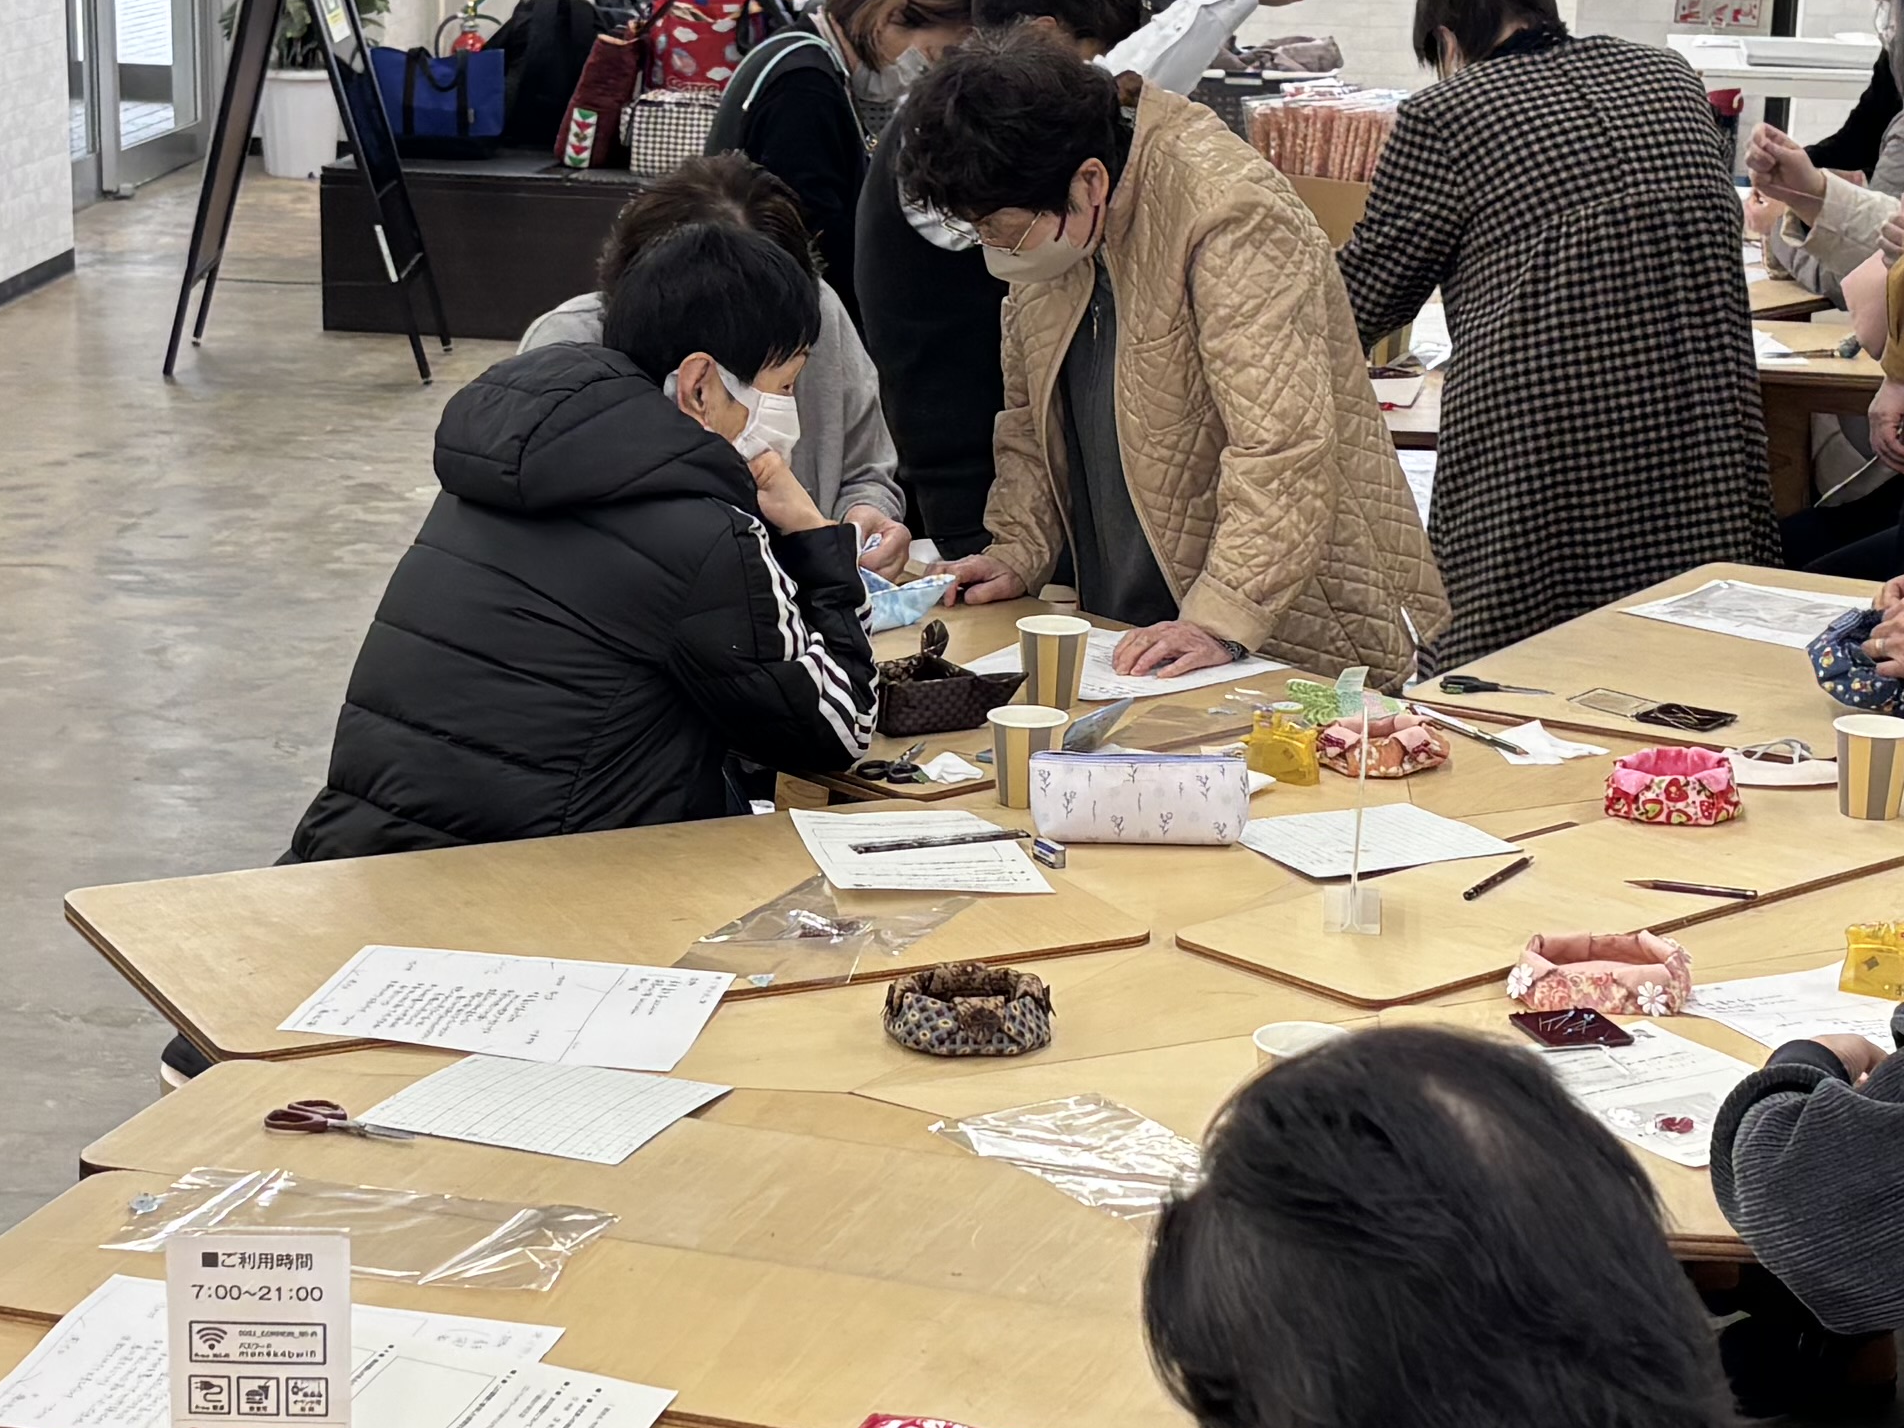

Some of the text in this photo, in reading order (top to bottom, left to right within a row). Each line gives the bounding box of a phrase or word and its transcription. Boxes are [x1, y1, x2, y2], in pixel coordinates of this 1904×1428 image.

[221, 1252, 313, 1271] ご利用時間
